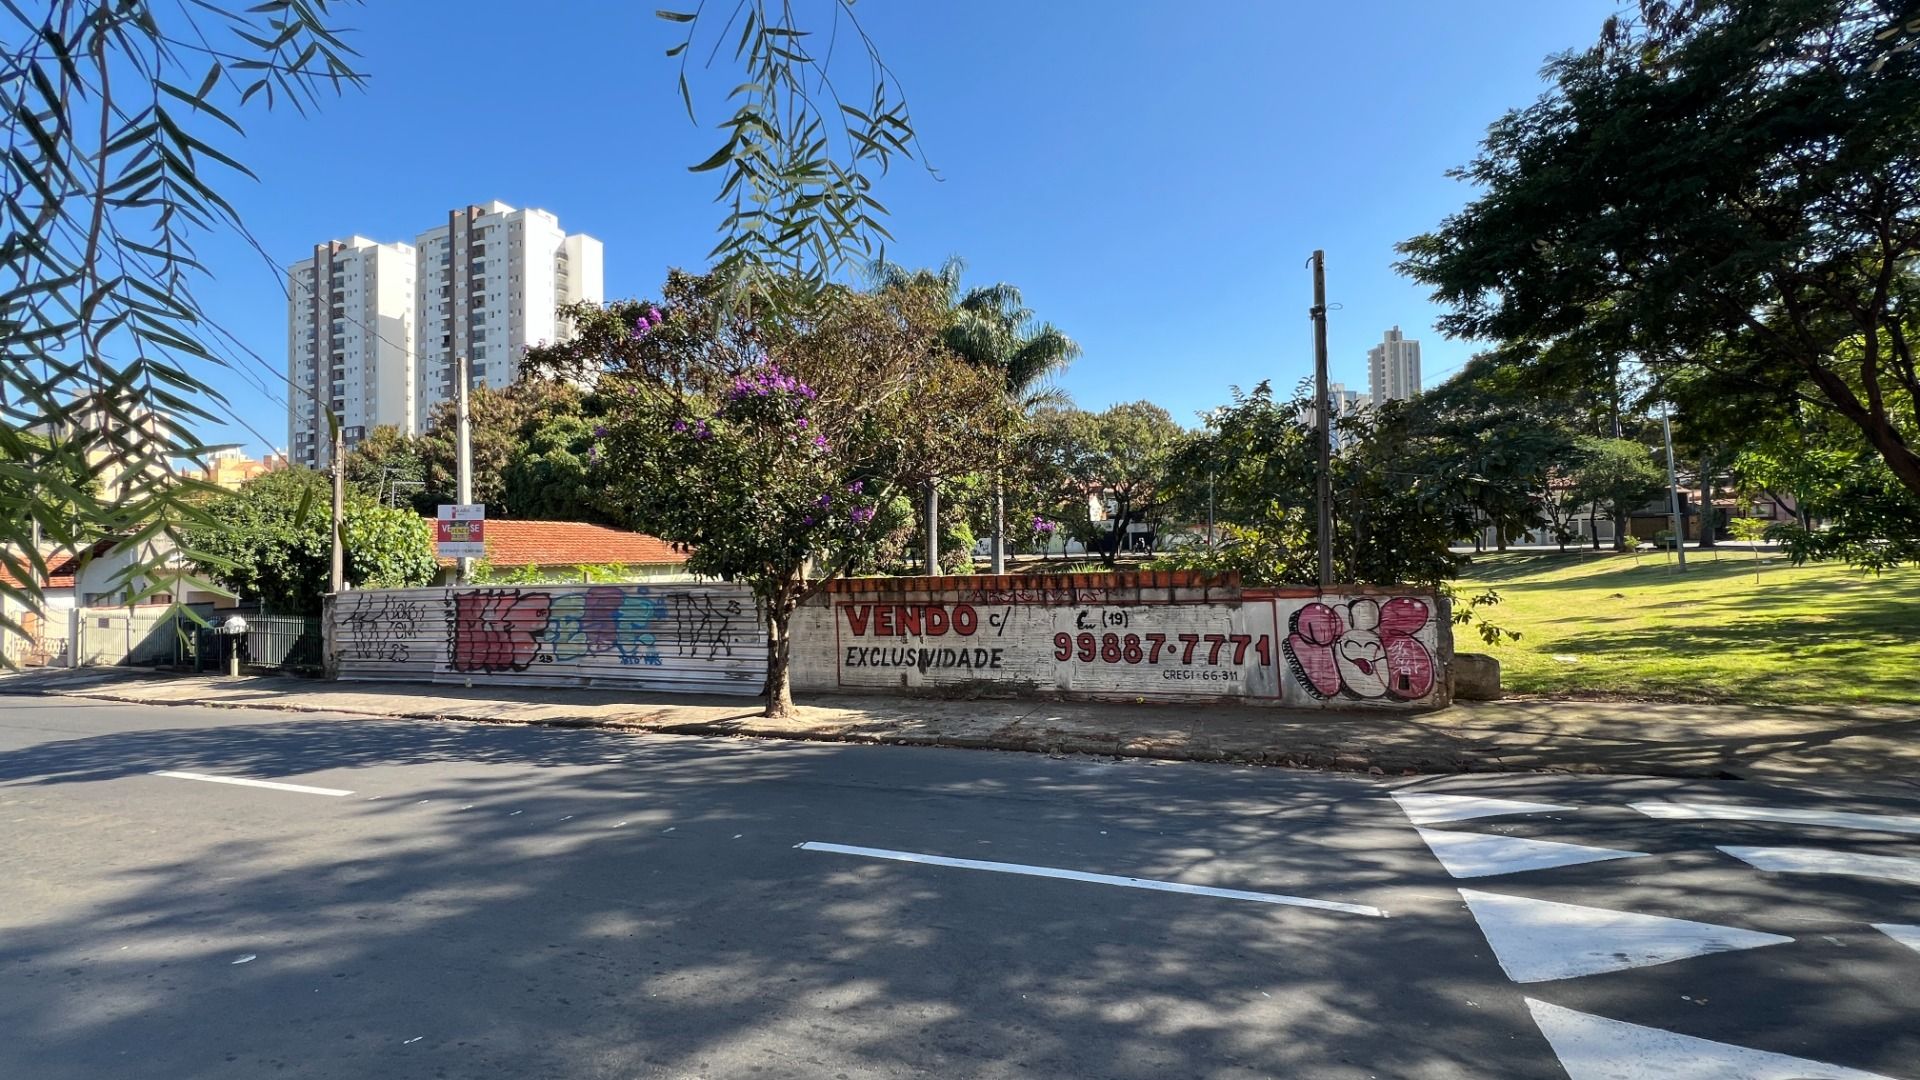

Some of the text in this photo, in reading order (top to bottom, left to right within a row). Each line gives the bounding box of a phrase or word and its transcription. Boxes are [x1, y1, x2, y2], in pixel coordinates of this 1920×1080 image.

[845, 605, 978, 636] VENDO
[1102, 610, 1129, 628] (19)
[845, 646, 1004, 670] EXCLUSIVIDADE
